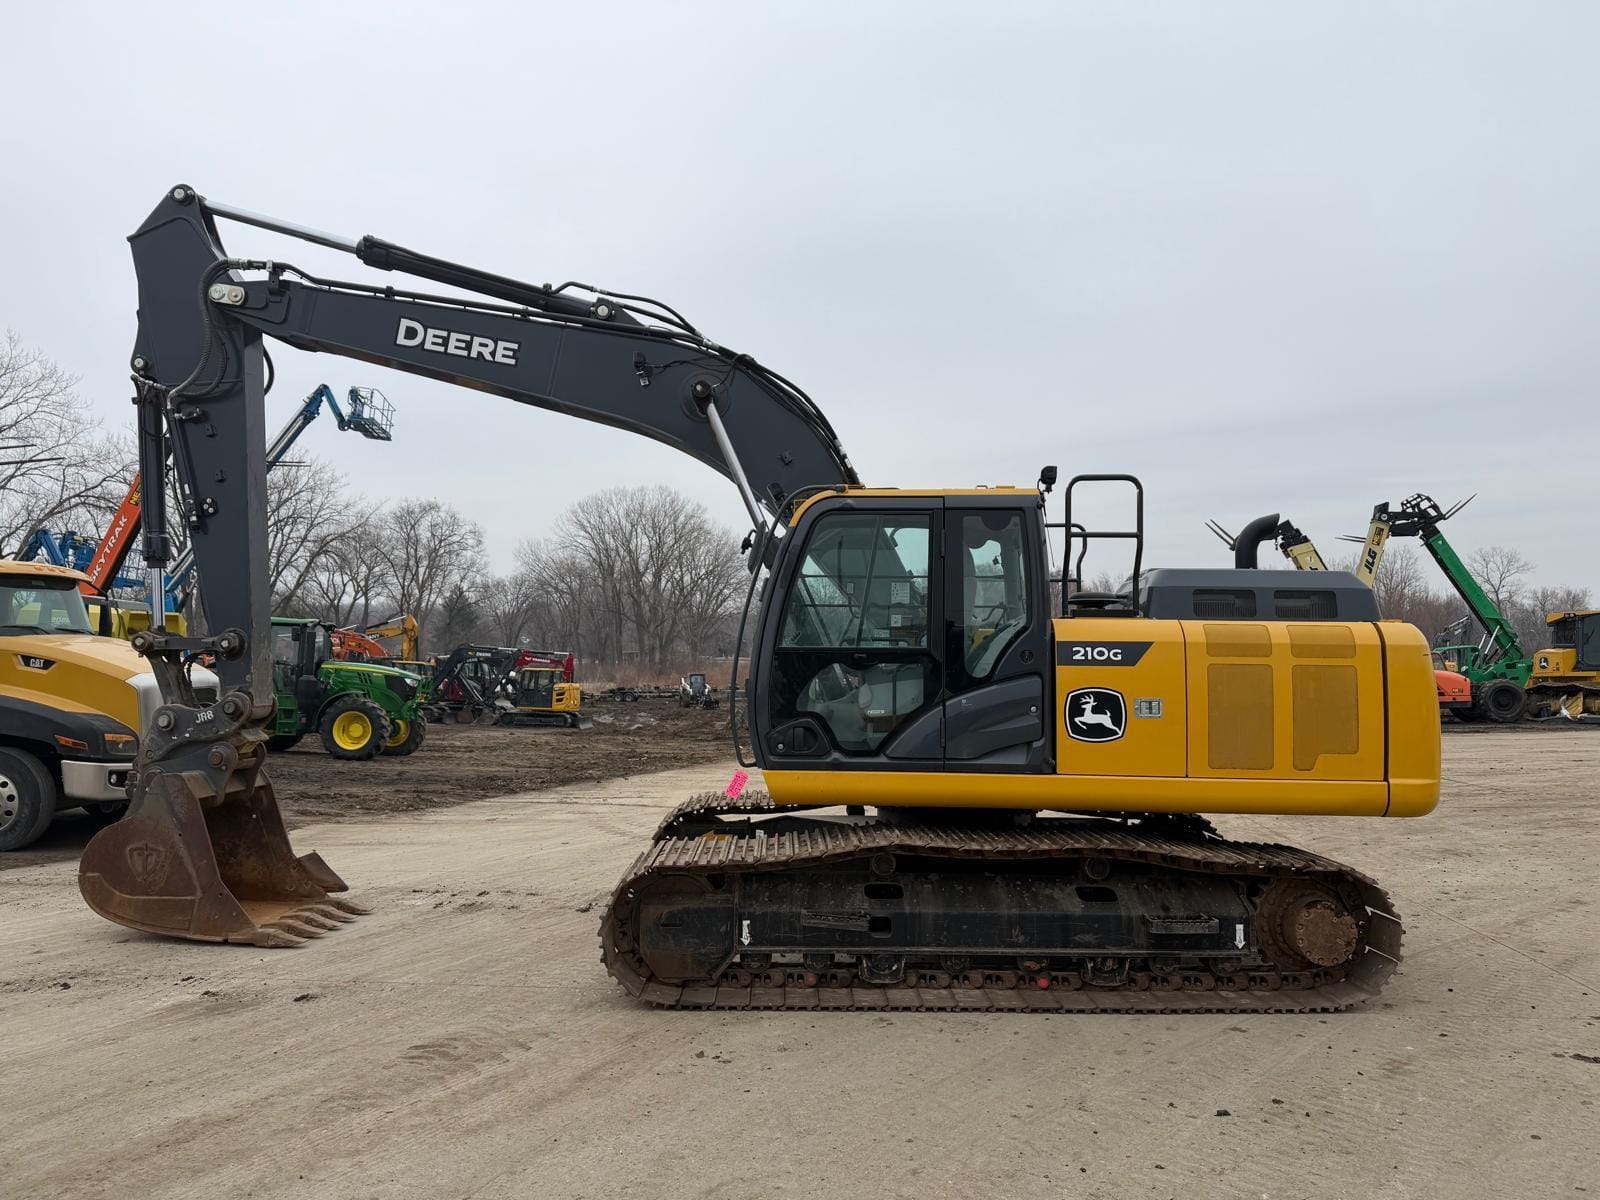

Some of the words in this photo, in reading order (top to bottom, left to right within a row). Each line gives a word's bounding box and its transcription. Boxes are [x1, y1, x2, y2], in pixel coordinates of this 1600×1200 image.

[396, 318, 519, 365] DEERE
[90, 515, 128, 584] SKYTRAK
[1364, 547, 1378, 574] JLG
[30, 658, 45, 668] CAT
[1072, 646, 1122, 660] 210G
